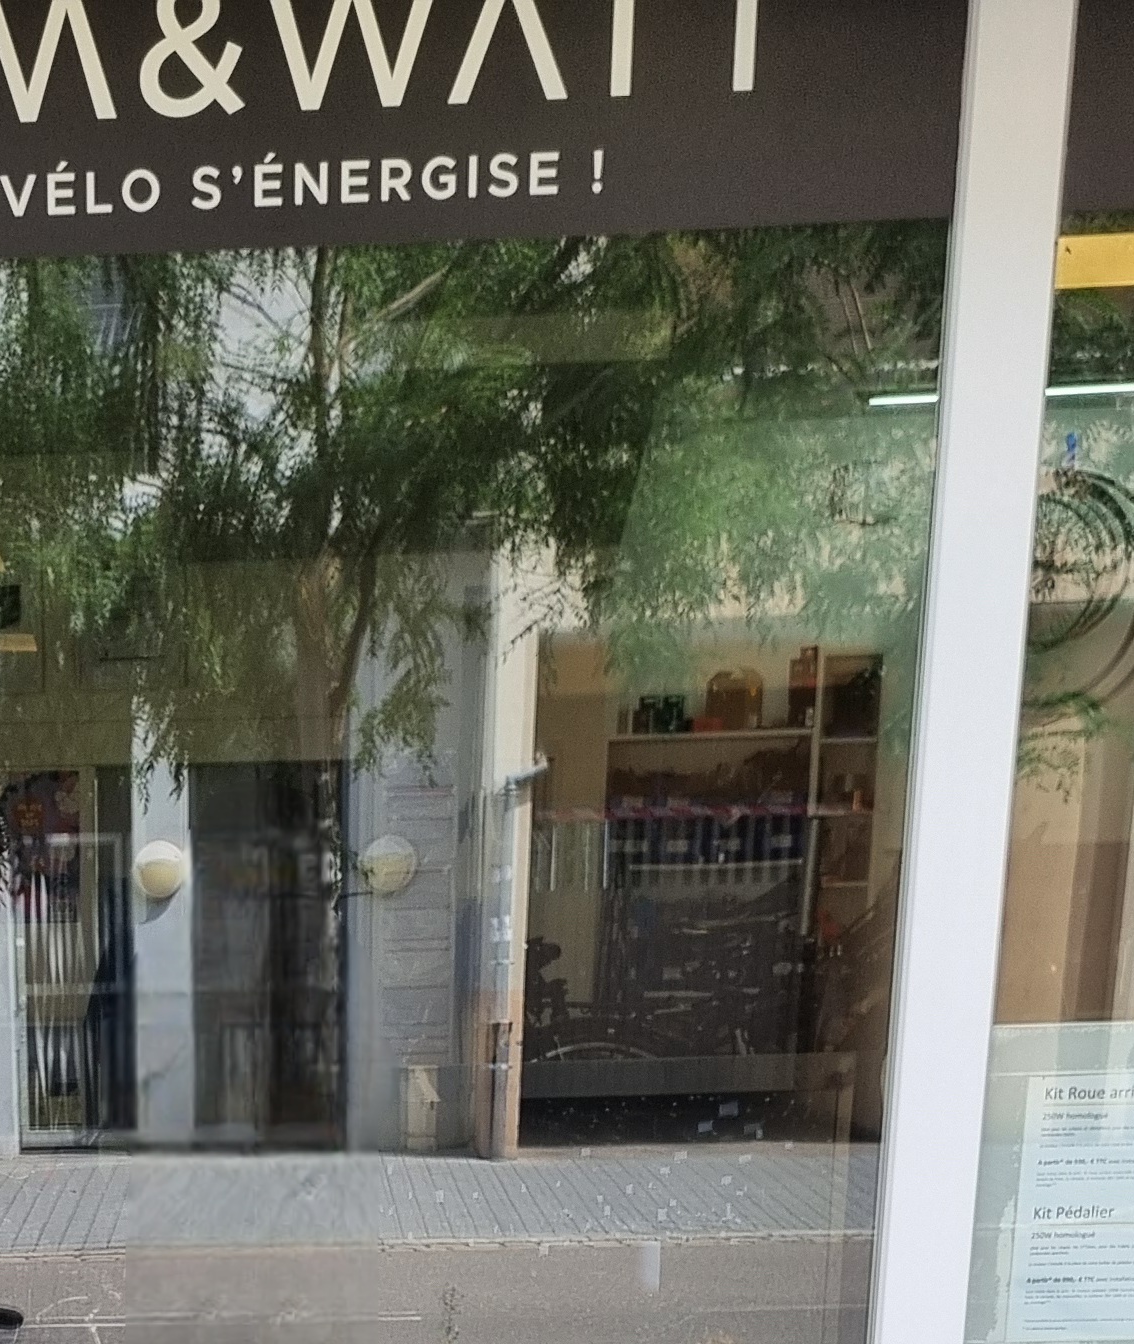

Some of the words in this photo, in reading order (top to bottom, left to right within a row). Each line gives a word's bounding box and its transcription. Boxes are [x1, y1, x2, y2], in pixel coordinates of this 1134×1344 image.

[0, 160, 161, 217] VÉLO
[191, 151, 561, 210] S'ÉNERGISE
[591, 148, 605, 195] !
[1045, 1087, 1064, 1100] Kit
[1068, 1086, 1106, 1100] Roue
[1033, 1206, 1053, 1220] Kit
[1056, 1205, 1115, 1219] Pédalier
